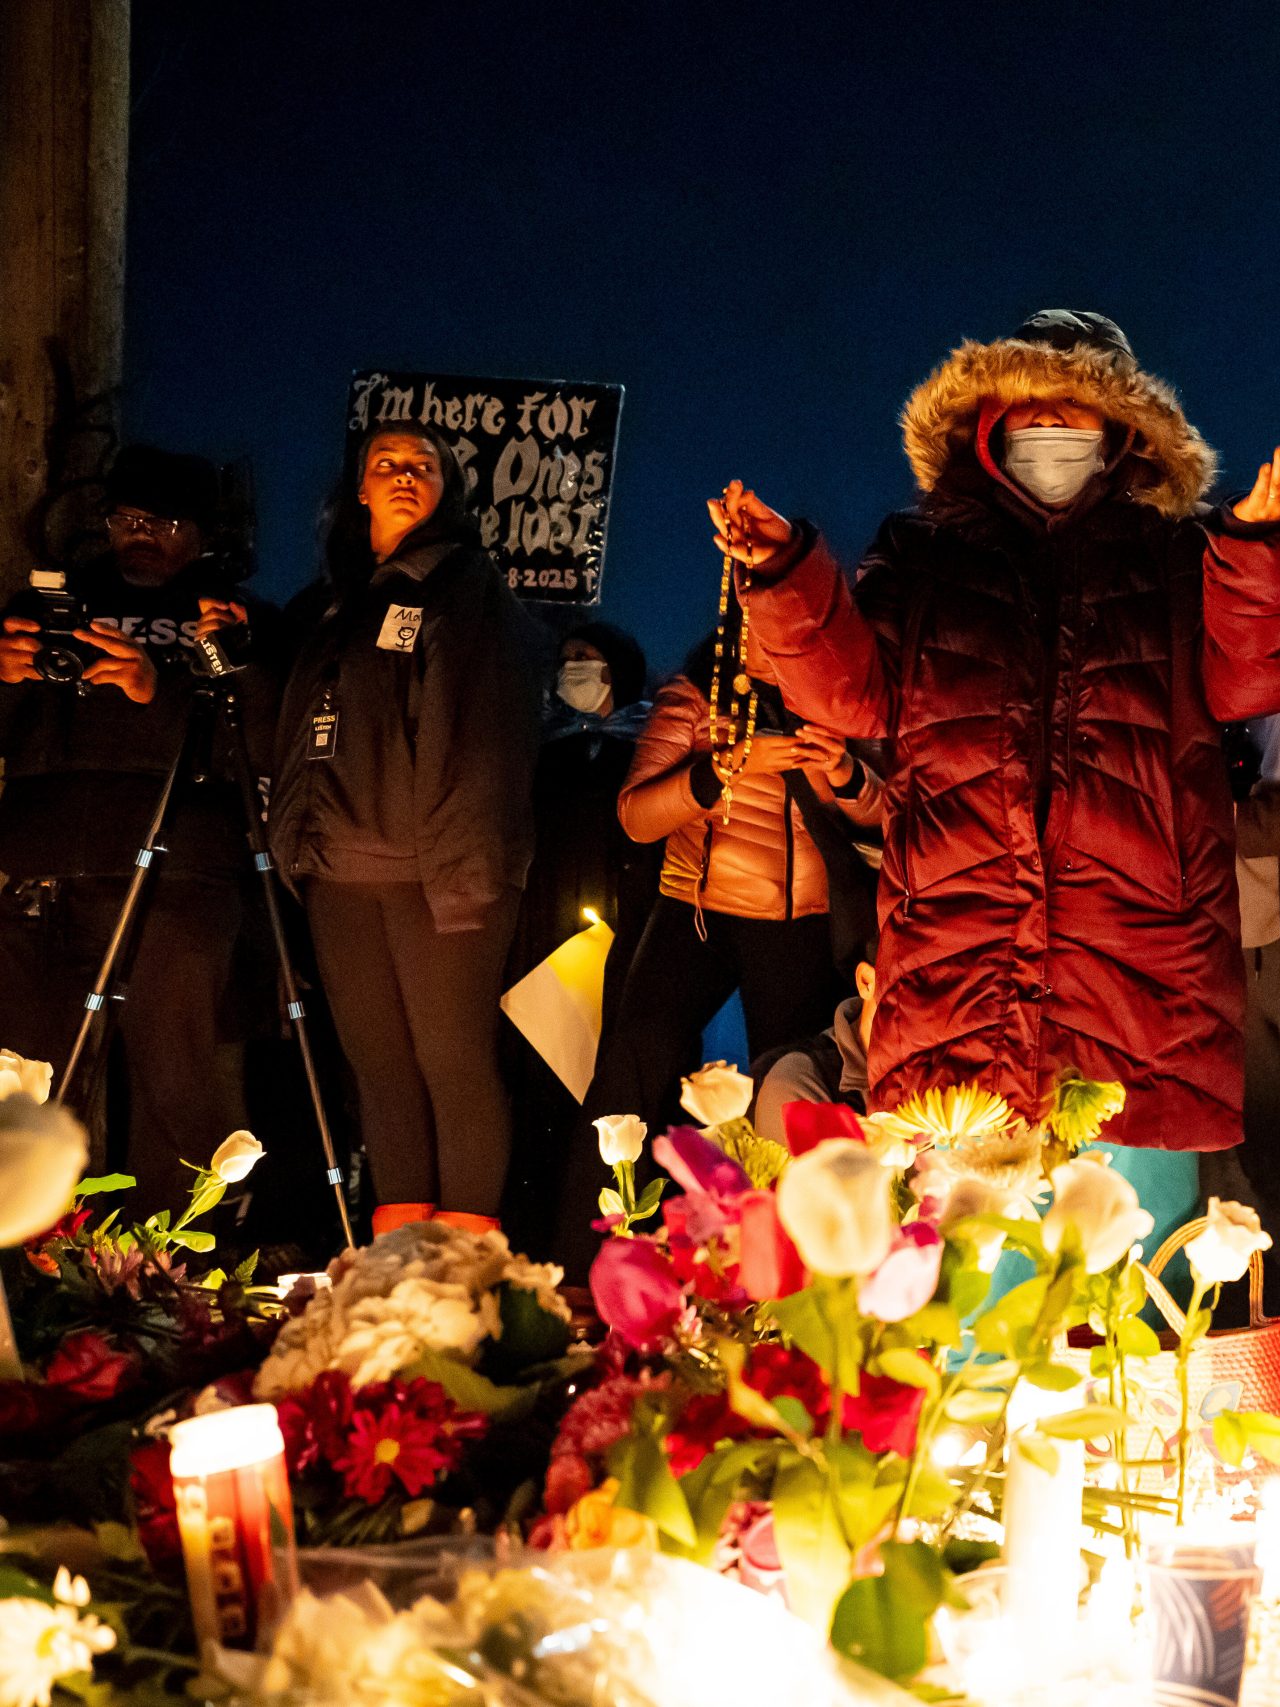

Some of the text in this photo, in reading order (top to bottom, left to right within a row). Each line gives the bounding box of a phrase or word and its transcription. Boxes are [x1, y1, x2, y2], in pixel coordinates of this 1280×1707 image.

[418, 380, 505, 436] here
[517, 391, 597, 441] for
[493, 433, 608, 505] Ones
[503, 499, 600, 557] lost
[313, 714, 336, 724] PRESS
